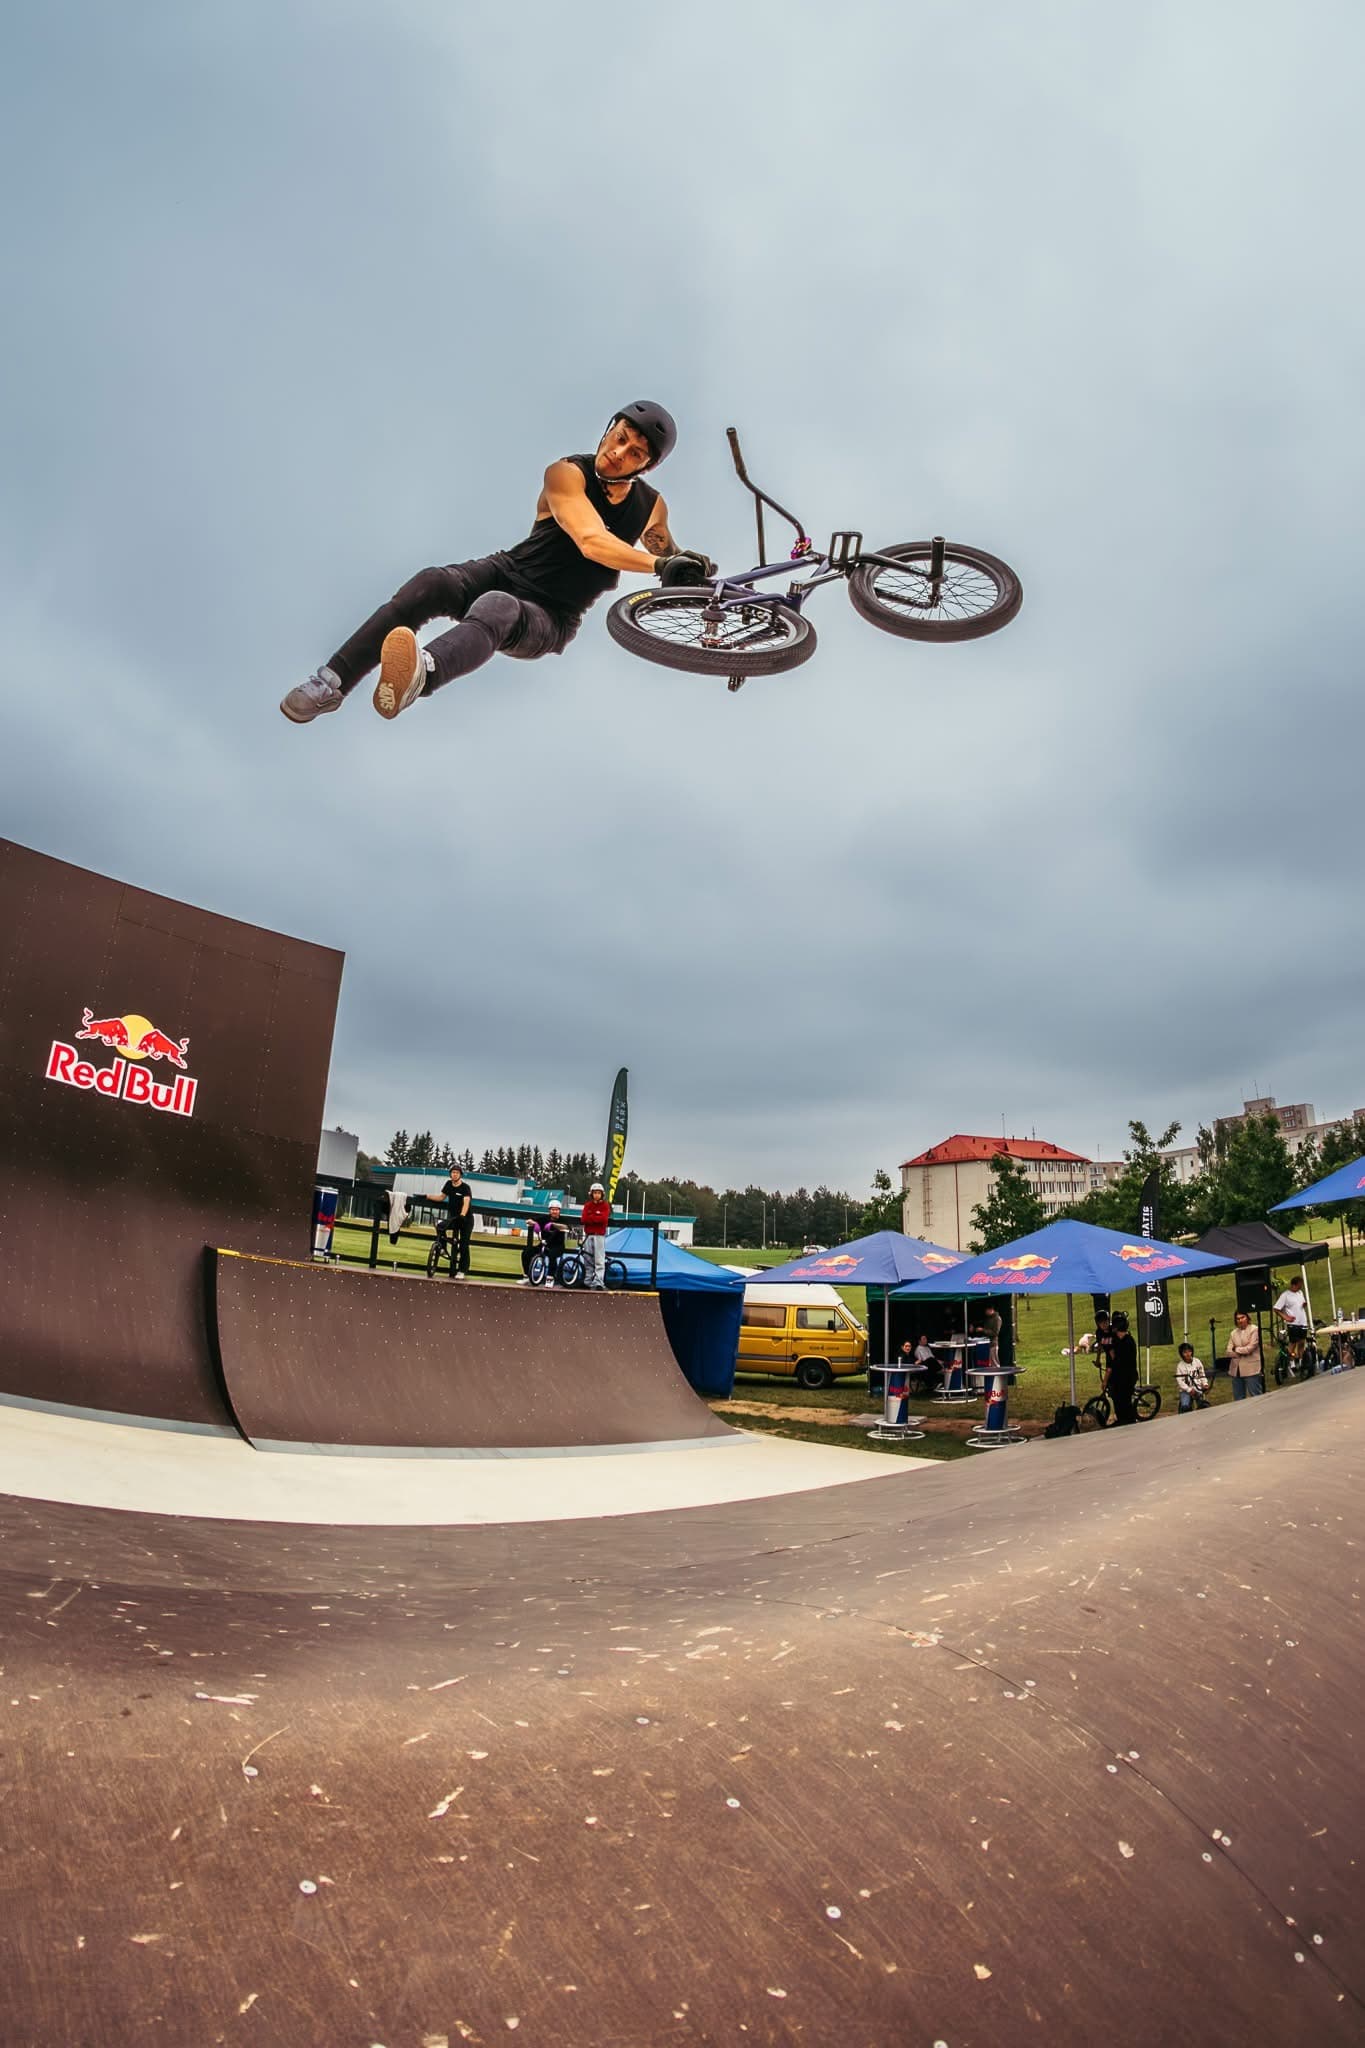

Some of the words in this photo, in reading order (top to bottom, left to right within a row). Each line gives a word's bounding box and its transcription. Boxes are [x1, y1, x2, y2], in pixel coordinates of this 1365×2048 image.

[47, 1041, 125, 1097] Red
[125, 1064, 197, 1115] Bull
[1142, 1206, 1151, 1238] RATIS
